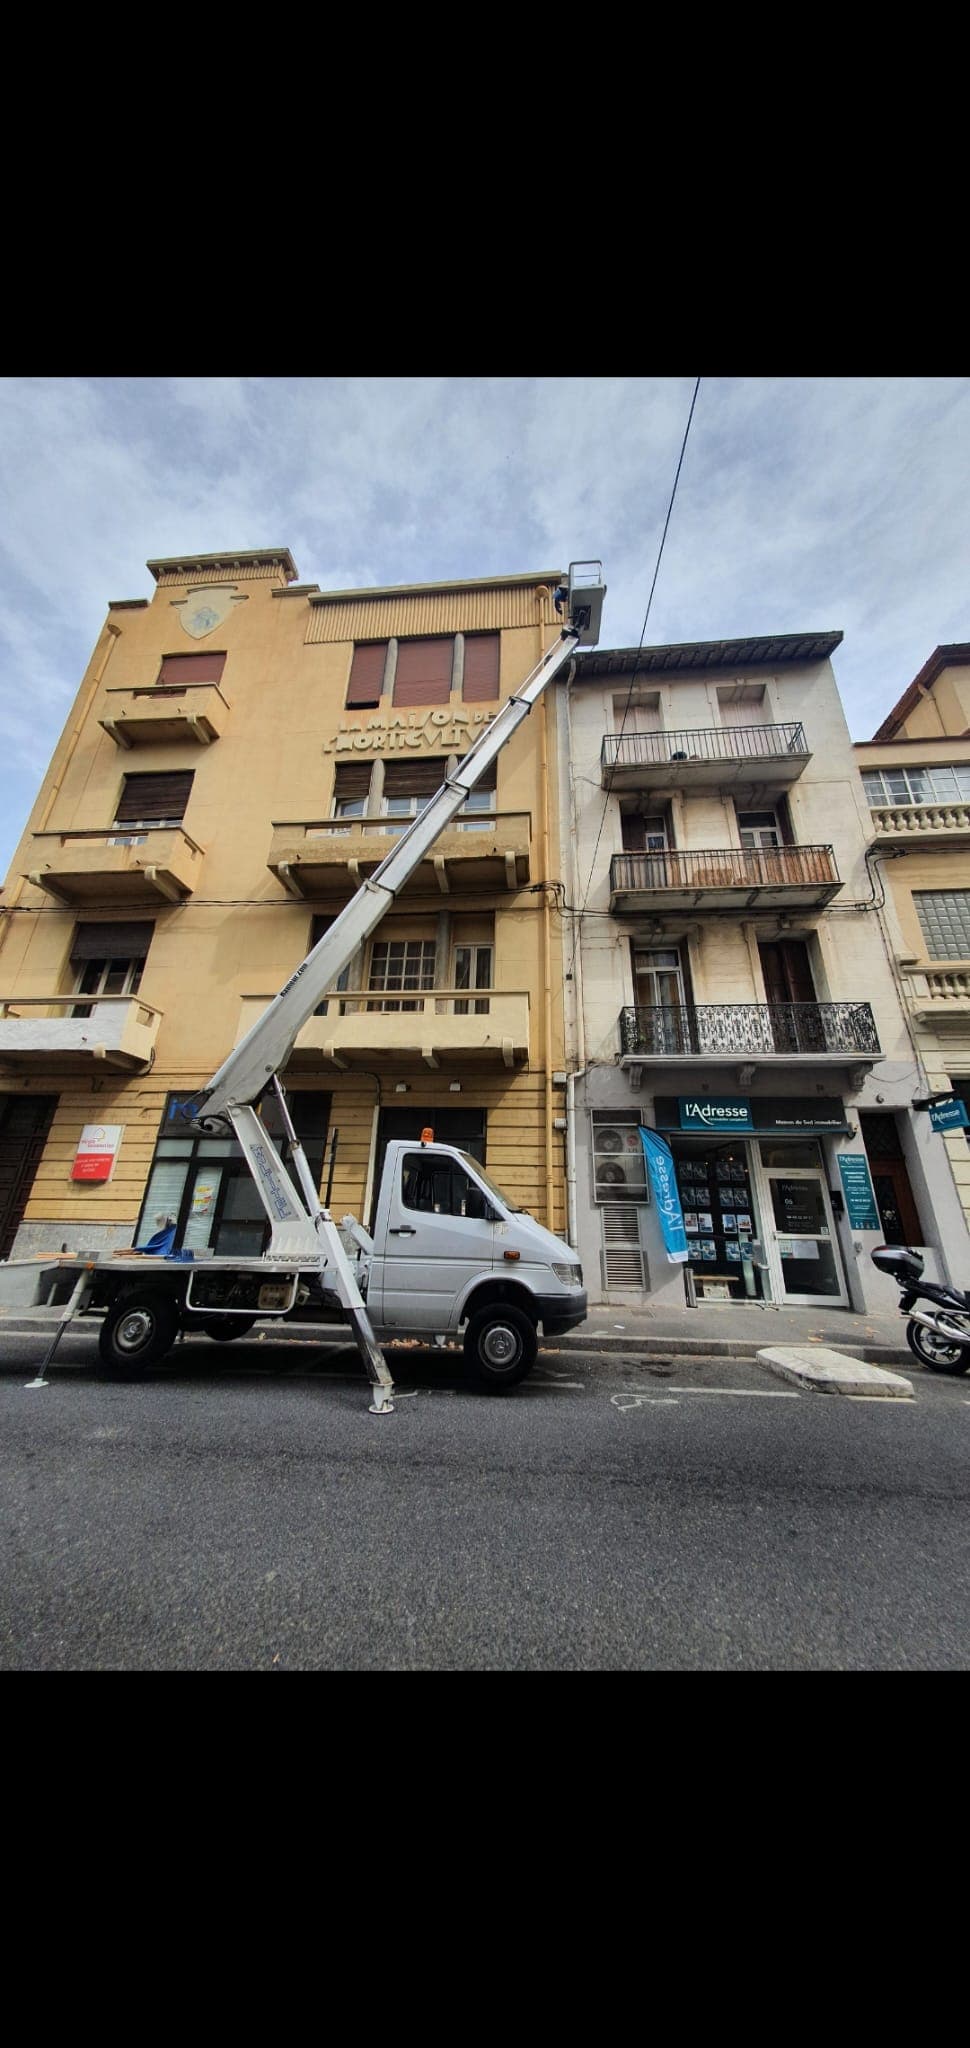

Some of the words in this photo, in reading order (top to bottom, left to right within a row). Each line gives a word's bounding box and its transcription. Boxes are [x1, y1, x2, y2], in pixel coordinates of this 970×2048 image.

[337, 719, 362, 733] LA
[685, 1103, 748, 1125] l'Adresse
[931, 1109, 960, 1124] l'Adresse
